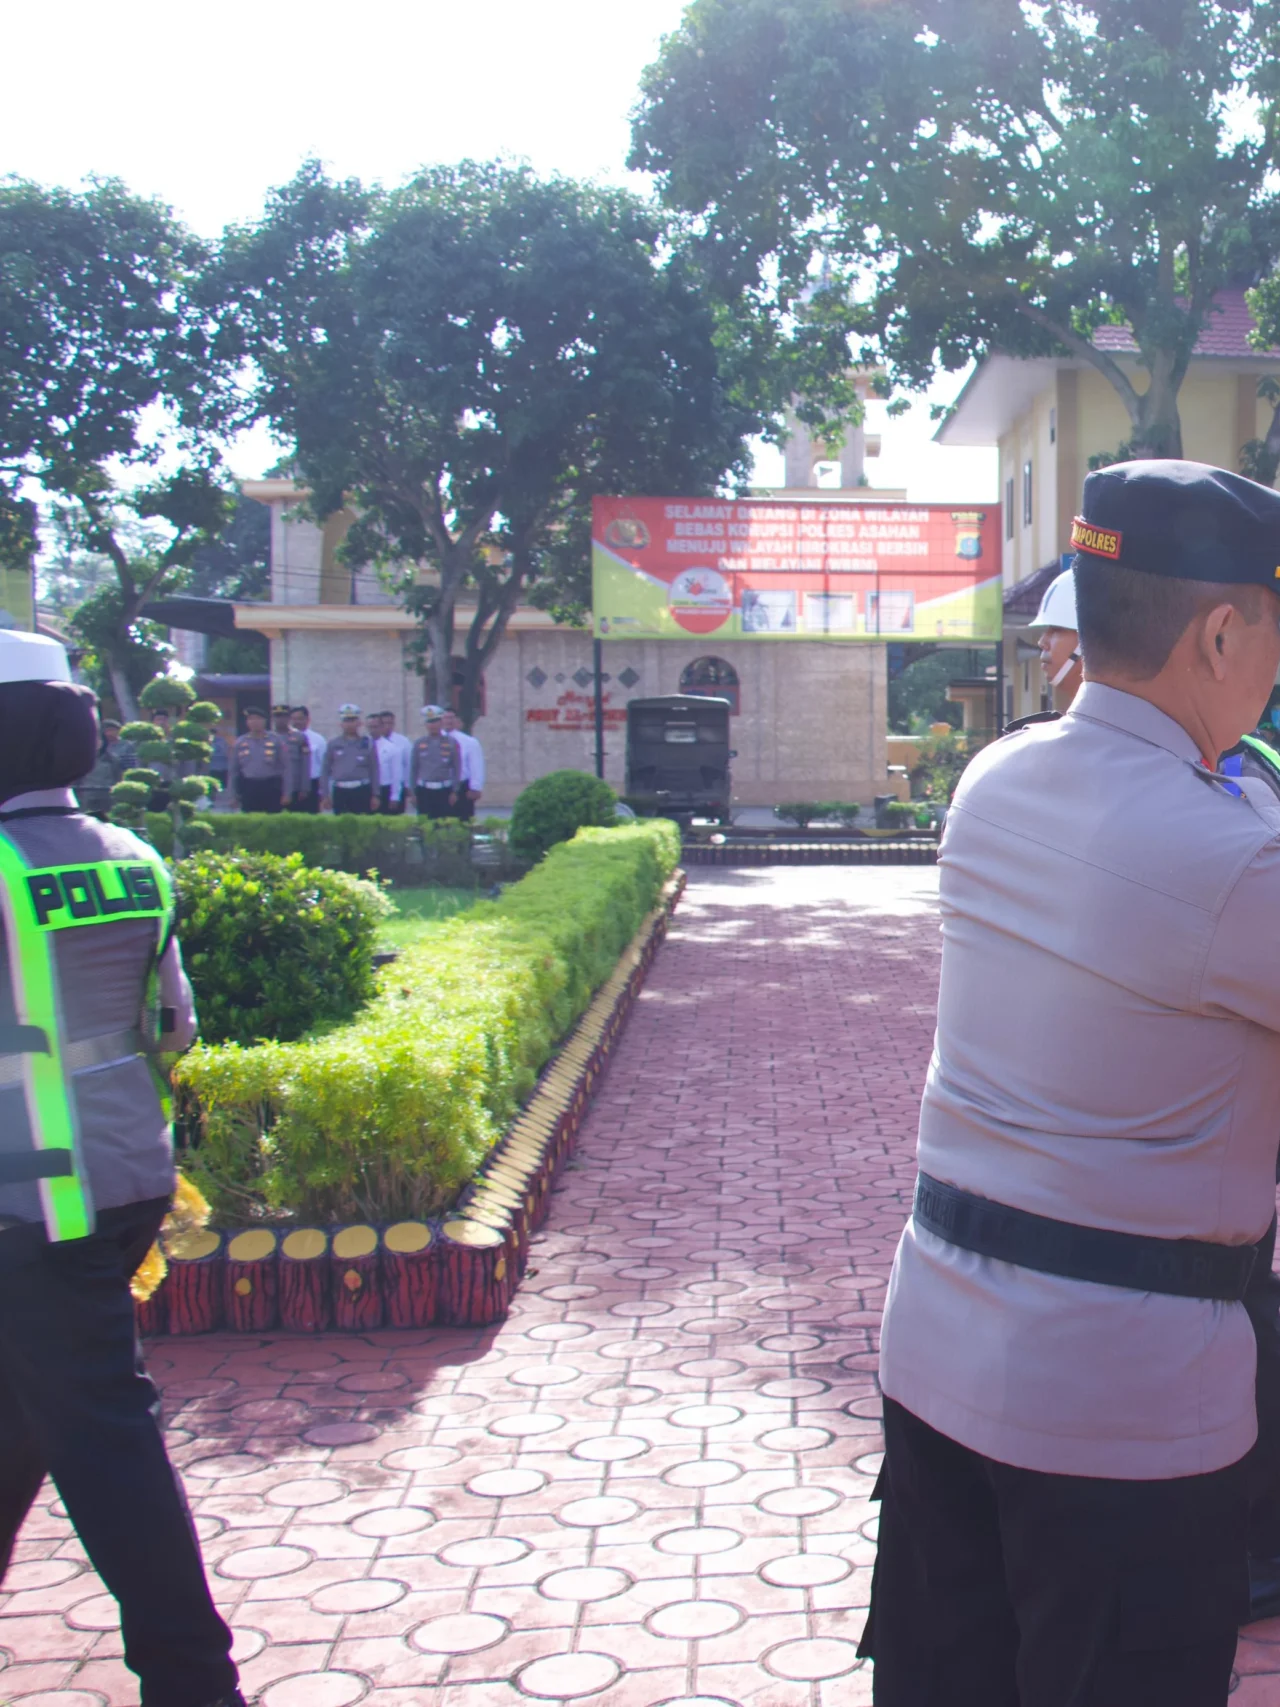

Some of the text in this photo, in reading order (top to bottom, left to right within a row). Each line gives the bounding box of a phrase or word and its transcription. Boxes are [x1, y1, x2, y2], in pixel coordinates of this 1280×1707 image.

[664, 504, 733, 519] SELAMAT
[737, 505, 797, 520] DATANG
[864, 507, 929, 522] WILAYAH
[674, 521, 920, 538] BEBAS KORUPSI POLRES ASAHAN
[666, 538, 726, 553] MENUJU
[730, 539, 793, 554] WILAYAH
